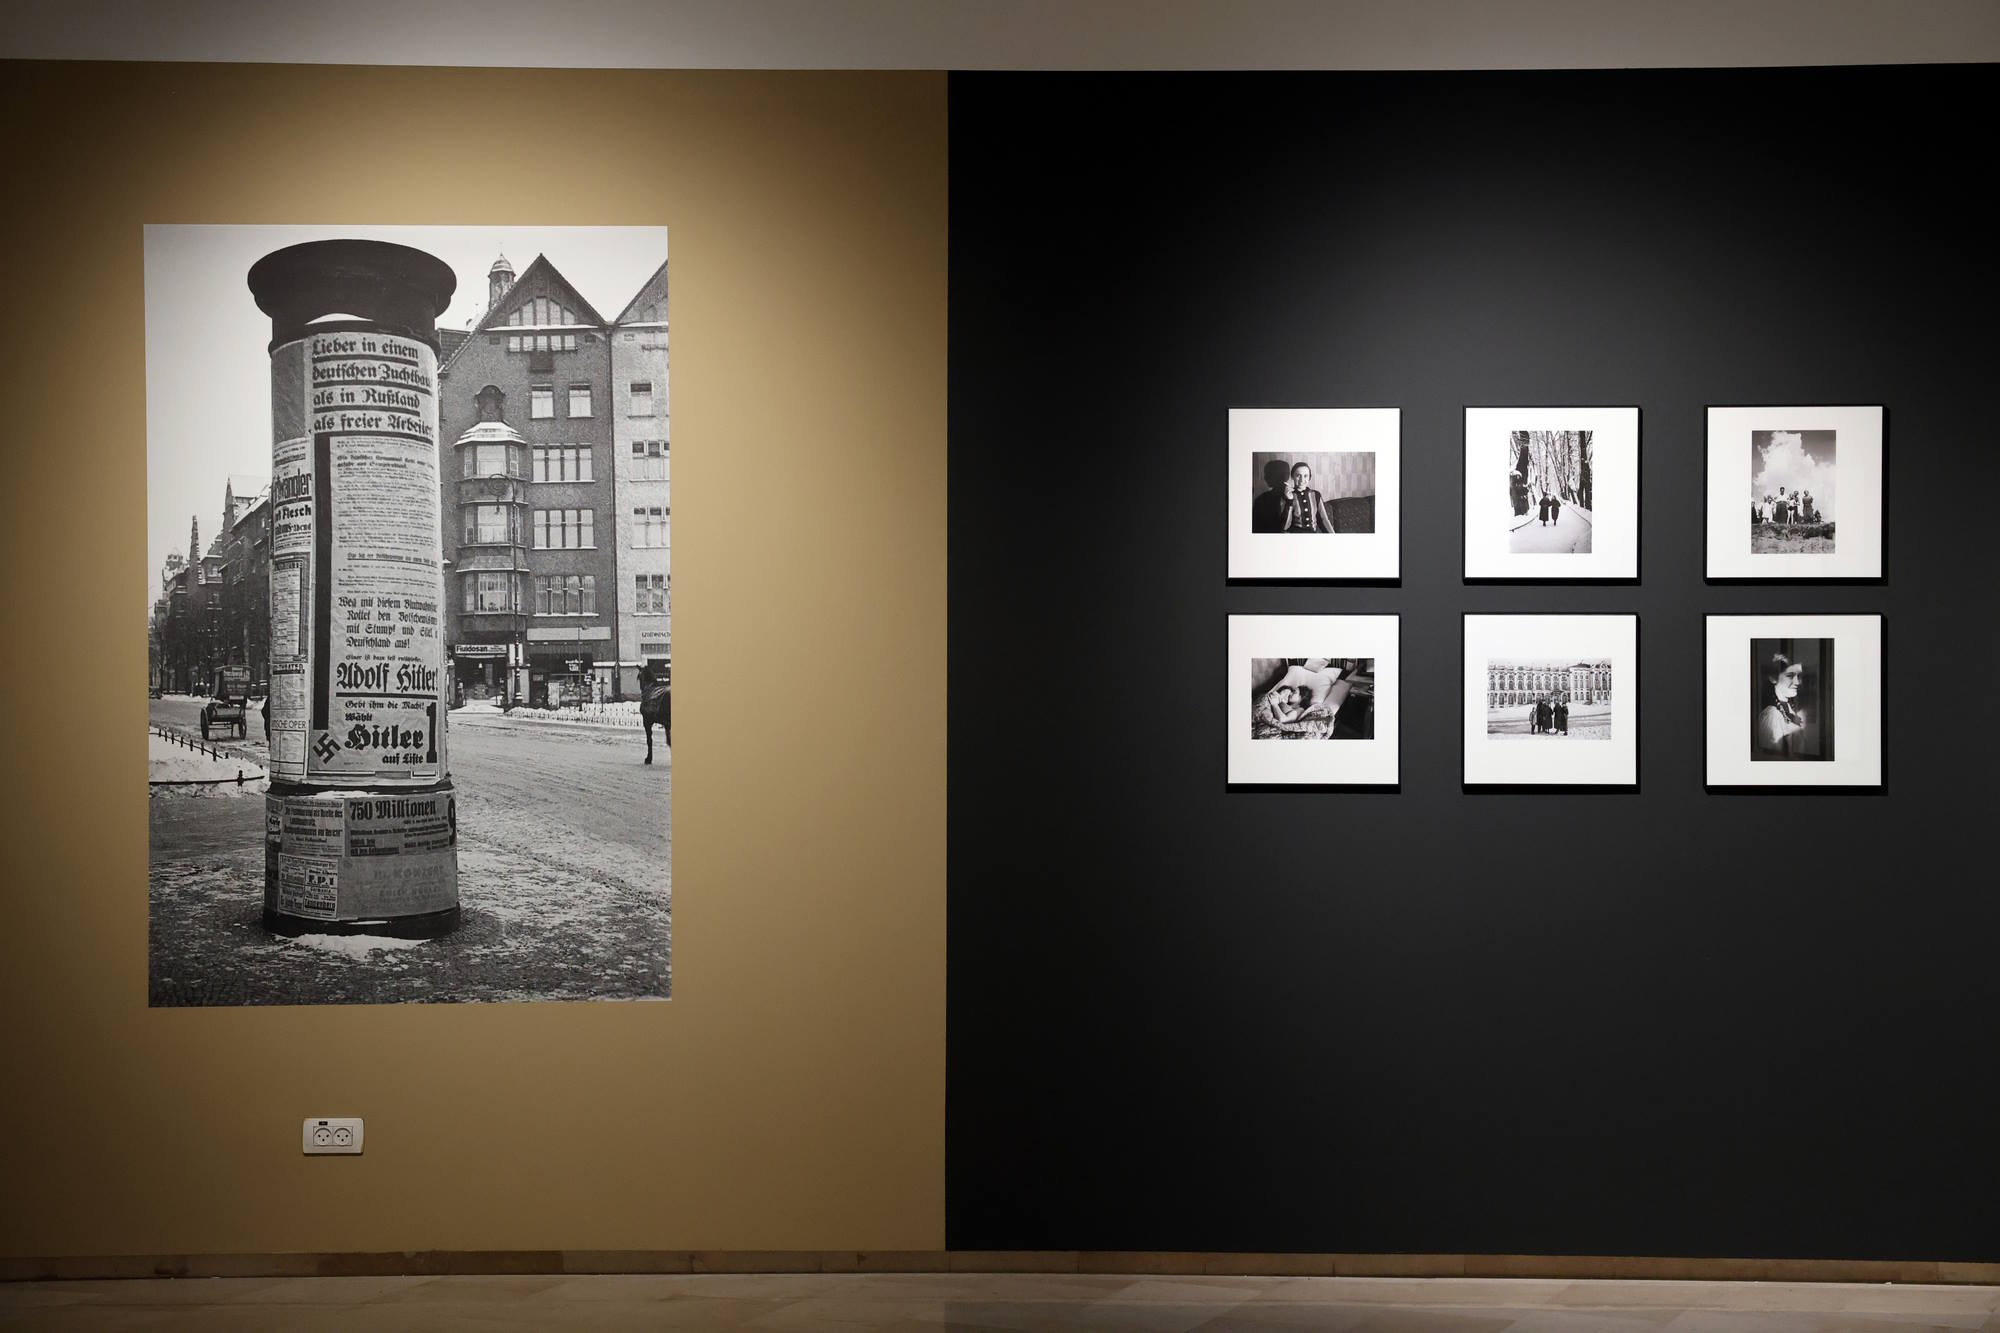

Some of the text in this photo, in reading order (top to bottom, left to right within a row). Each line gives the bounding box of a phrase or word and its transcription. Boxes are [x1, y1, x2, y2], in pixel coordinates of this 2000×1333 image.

[312, 337, 418, 359] Lieber in einem
[312, 362, 377, 380] deutschen
[313, 390, 334, 406] als
[340, 387, 355, 403] in
[313, 414, 335, 431] als
[340, 413, 382, 431] freier
[346, 622, 360, 634] mit
[402, 625, 415, 636] und
[345, 636, 391, 648] Deutschland
[336, 662, 390, 693] Adolf
[345, 700, 366, 709] Gebt
[369, 700, 384, 710] ihm
[387, 700, 398, 709] die
[344, 724, 424, 751] Hitler
[382, 752, 424, 766] auf Liste
[350, 801, 373, 820] 750
[375, 798, 436, 819] Millionen
